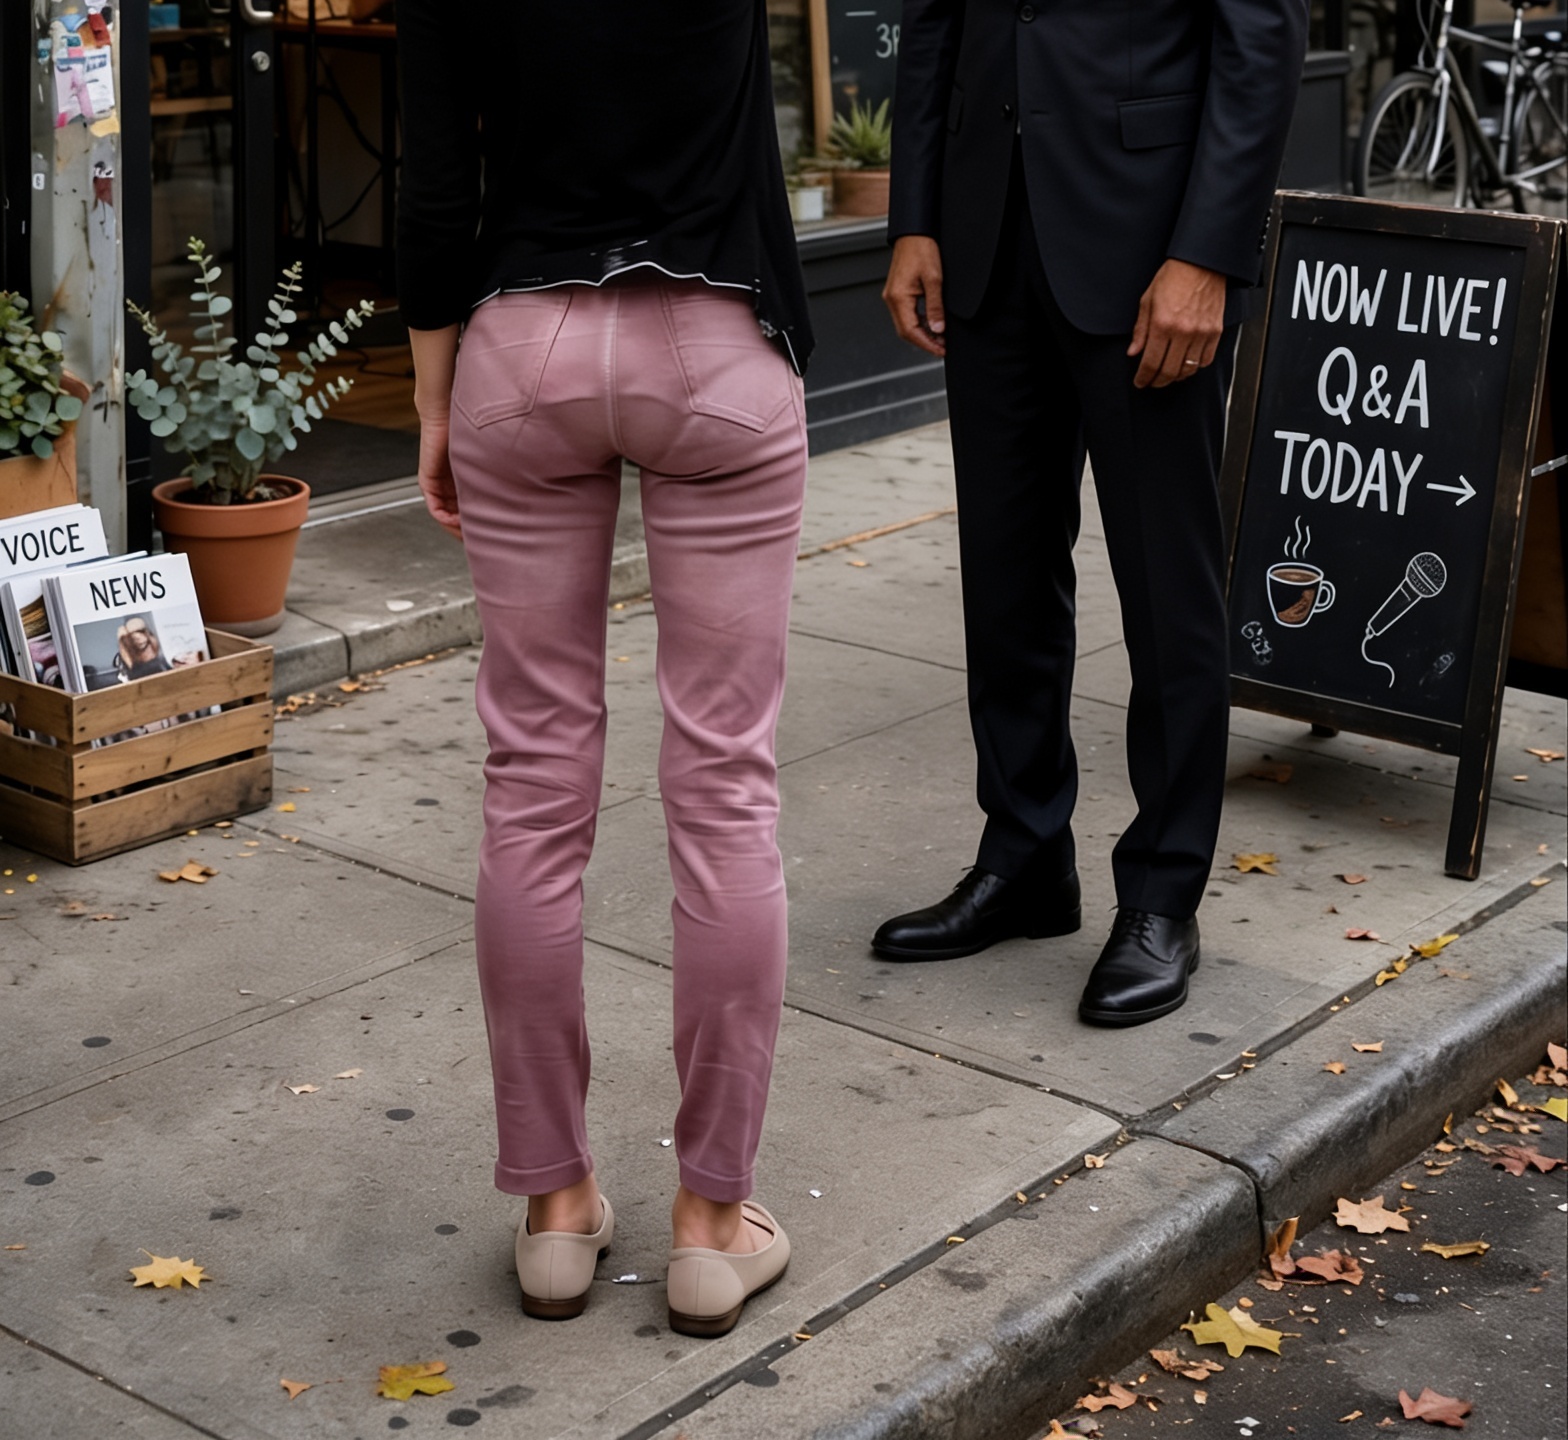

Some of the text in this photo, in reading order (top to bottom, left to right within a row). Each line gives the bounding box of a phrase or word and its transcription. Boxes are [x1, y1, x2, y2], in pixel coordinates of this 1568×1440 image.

[1291, 259, 1507, 346] NOW LIVE!
[1317, 346, 1430, 428] Q&A
[1274, 430, 1424, 516] TODAY
[0, 522, 85, 565] VOICE
[89, 571, 166, 611] NEWS
